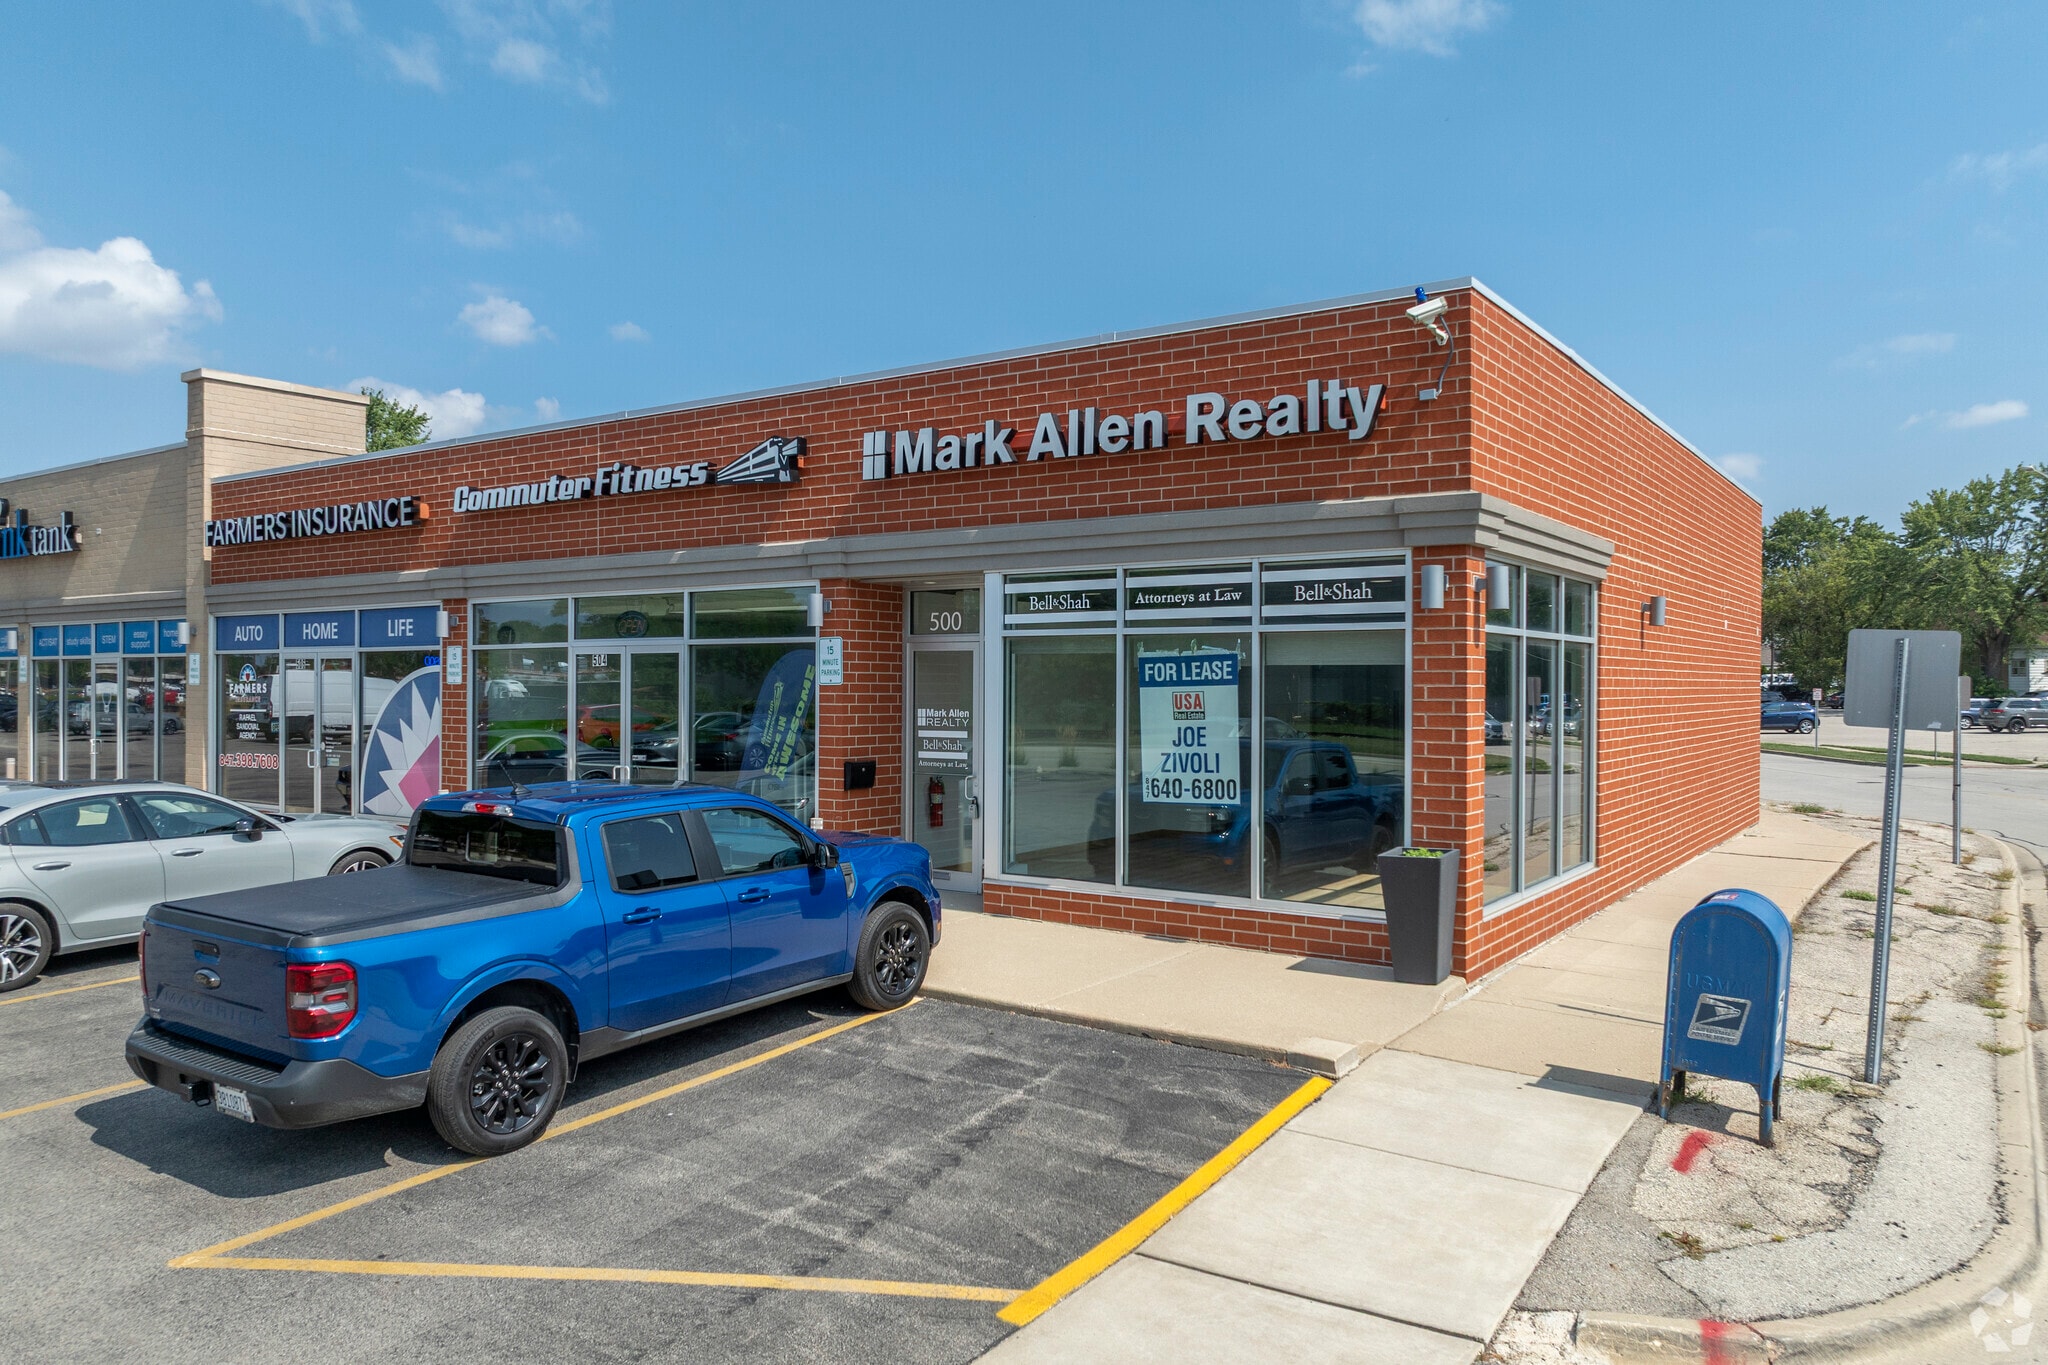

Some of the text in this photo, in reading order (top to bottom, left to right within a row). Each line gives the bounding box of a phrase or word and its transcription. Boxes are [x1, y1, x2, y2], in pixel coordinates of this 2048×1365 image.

[895, 378, 1384, 475] Mark Allen Realty
[453, 462, 710, 513] Commuter Fitness
[205, 495, 415, 547] FARMERS INSURANCE
[0, 508, 74, 559] nk tank
[1135, 588, 1242, 606] Attorneys at Law
[1294, 581, 1373, 602] Bell&Shah
[1029, 594, 1091, 612] Bell&Shah
[387, 618, 414, 637] LIFE
[929, 611, 962, 631] 500
[163, 628, 179, 637] home
[234, 625, 263, 642] AUTO
[302, 622, 338, 640] HOME
[826, 645, 834, 655] 15
[593, 654, 606, 666] 504
[822, 658, 839, 666] MINUTE
[821, 668, 841, 677] PARKING
[1144, 660, 1233, 682] FOR LEASE
[229, 683, 267, 694] FARMERS
[1174, 692, 1203, 711] USA
[238, 713, 257, 721] RAFAEL
[776, 663, 816, 781] AWESOME
[926, 708, 970, 718] Mark Allen
[926, 717, 970, 727] REALTY
[1174, 711, 1205, 720] Real Estate
[236, 722, 260, 731] SANDOVAL
[239, 731, 258, 740] AGENCY
[764, 732, 782, 774] COME
[777, 715, 787, 732] IN
[1172, 726, 1207, 747] JOE
[219, 752, 279, 770] 847.398.7608
[919, 759, 946, 769] Attorneys
[955, 760, 967, 768] Law
[1160, 752, 1220, 774] ZIVOLI
[1151, 778, 1237, 801] 640-6800
